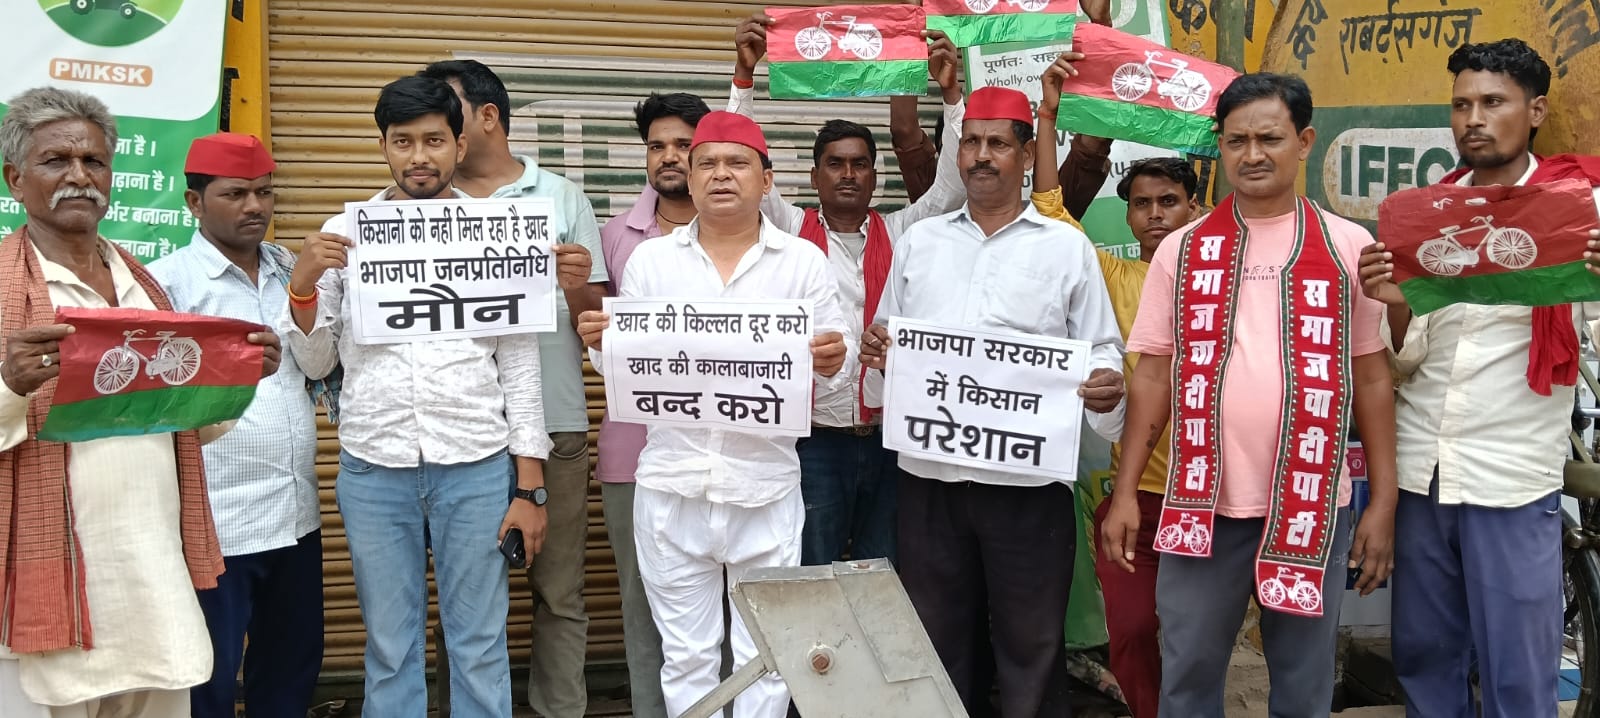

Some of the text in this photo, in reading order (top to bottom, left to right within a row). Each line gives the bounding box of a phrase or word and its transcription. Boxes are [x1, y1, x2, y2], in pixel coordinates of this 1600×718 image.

[55, 61, 146, 85] PMKSK
[984, 56, 1023, 73] पूर्णतः
[984, 74, 1023, 87] Wholly
[111, 171, 150, 192] ढ़ाना
[1341, 144, 1465, 197] IFFC
[132, 206, 179, 226] बनाना
[358, 204, 549, 245] किसानों को नहीं मिल रहा है खाद
[360, 246, 550, 285] भाजपा जनप्रतिनिधि
[379, 283, 526, 332] मौन
[616, 304, 809, 343] खाद की किल्लत दूर करो
[627, 351, 793, 380] खाद की कालाबाजारी
[897, 328, 1073, 371] भाजपा सरकार
[632, 383, 785, 424] बन्द करो
[926, 371, 1043, 415] में किसान
[904, 405, 1047, 467] परेशान
